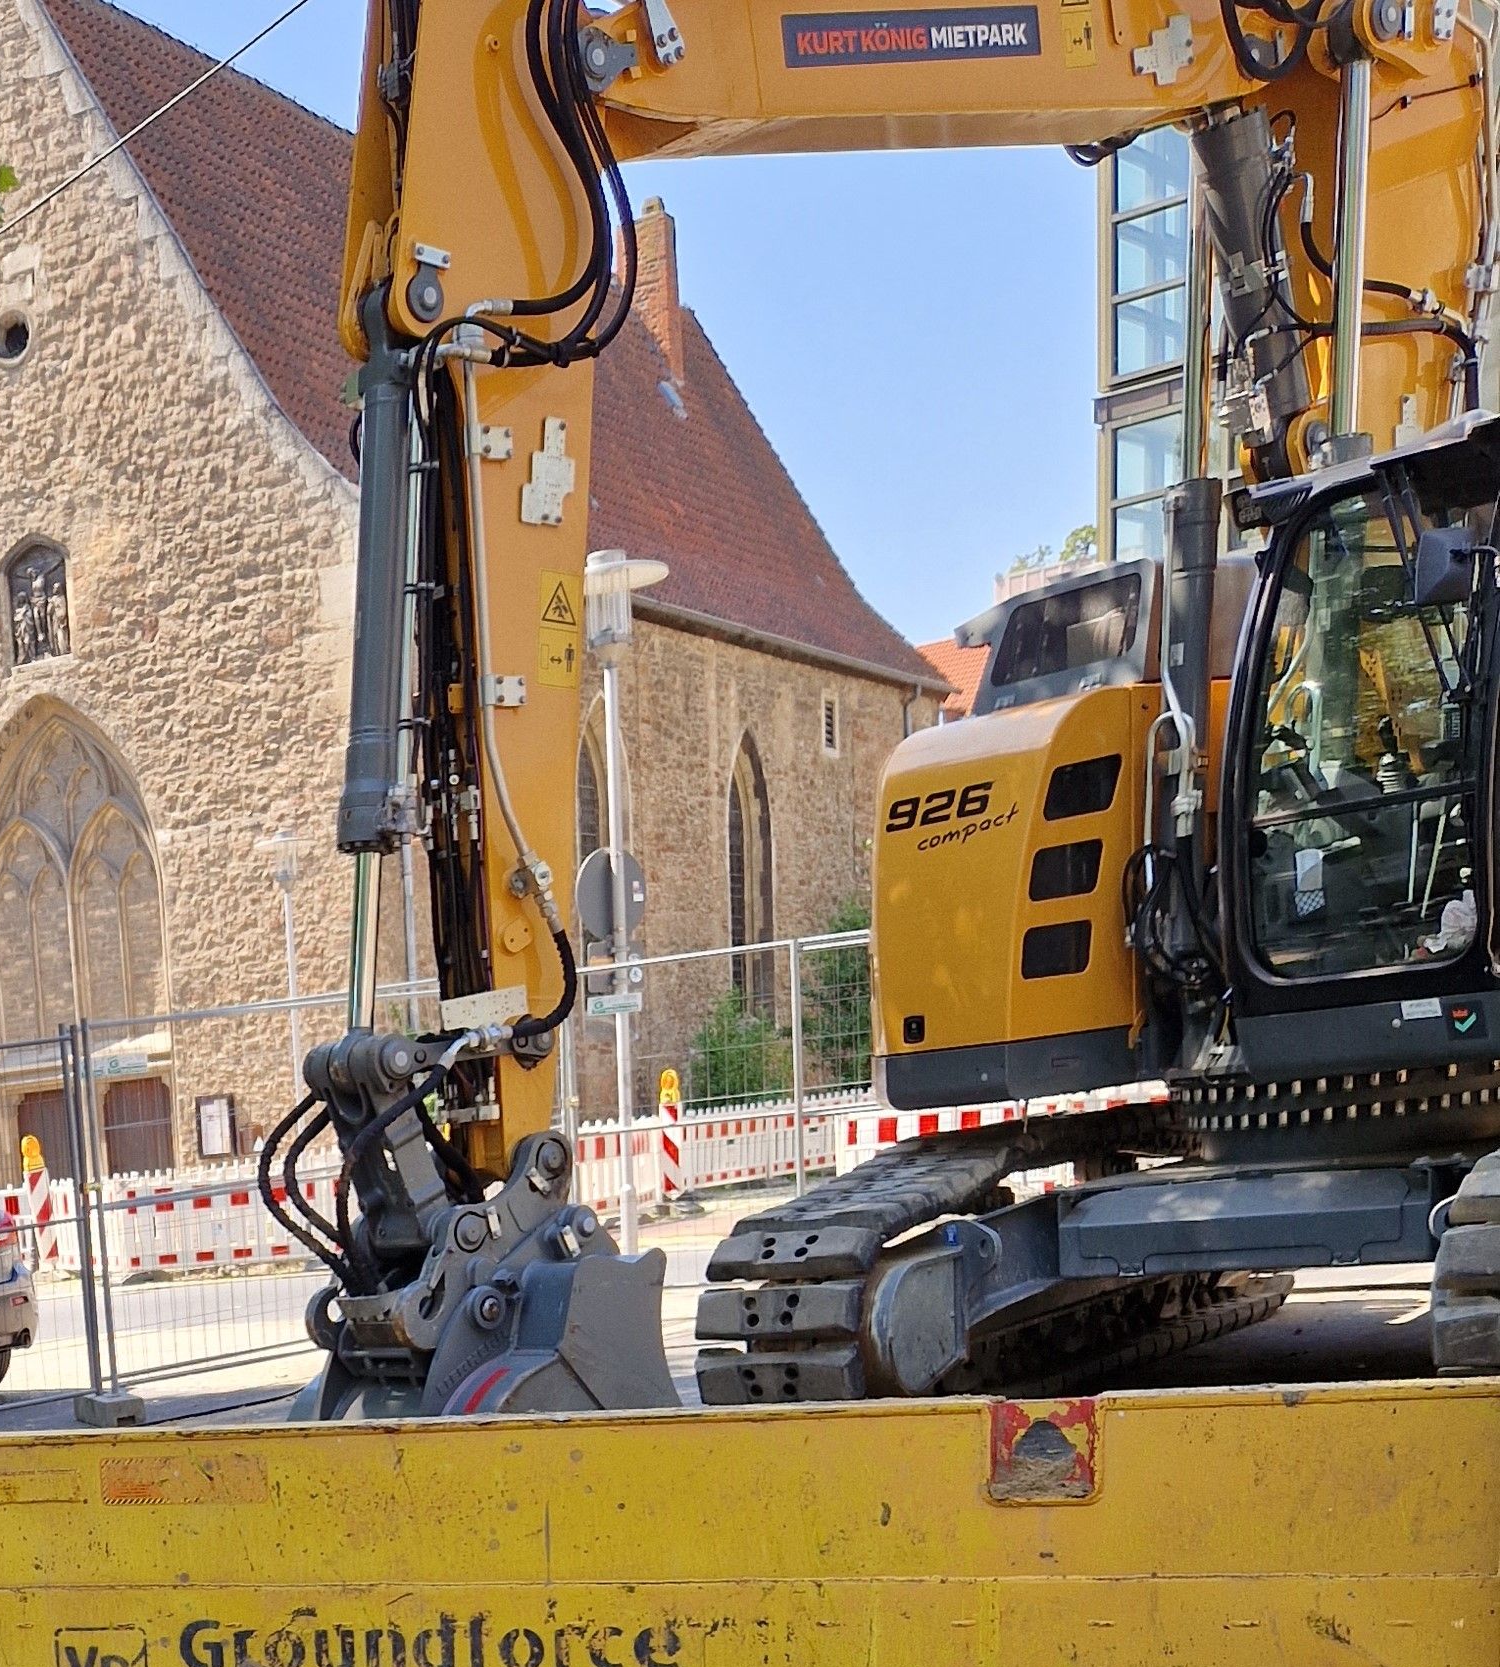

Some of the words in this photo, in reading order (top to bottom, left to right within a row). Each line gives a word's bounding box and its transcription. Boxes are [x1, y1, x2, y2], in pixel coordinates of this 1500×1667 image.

[796, 29, 857, 55] KURT
[860, 22, 927, 51] KÖNIG
[930, 22, 1028, 49] MIETPARK
[886, 780, 995, 833] 926
[917, 801, 1019, 851] compact
